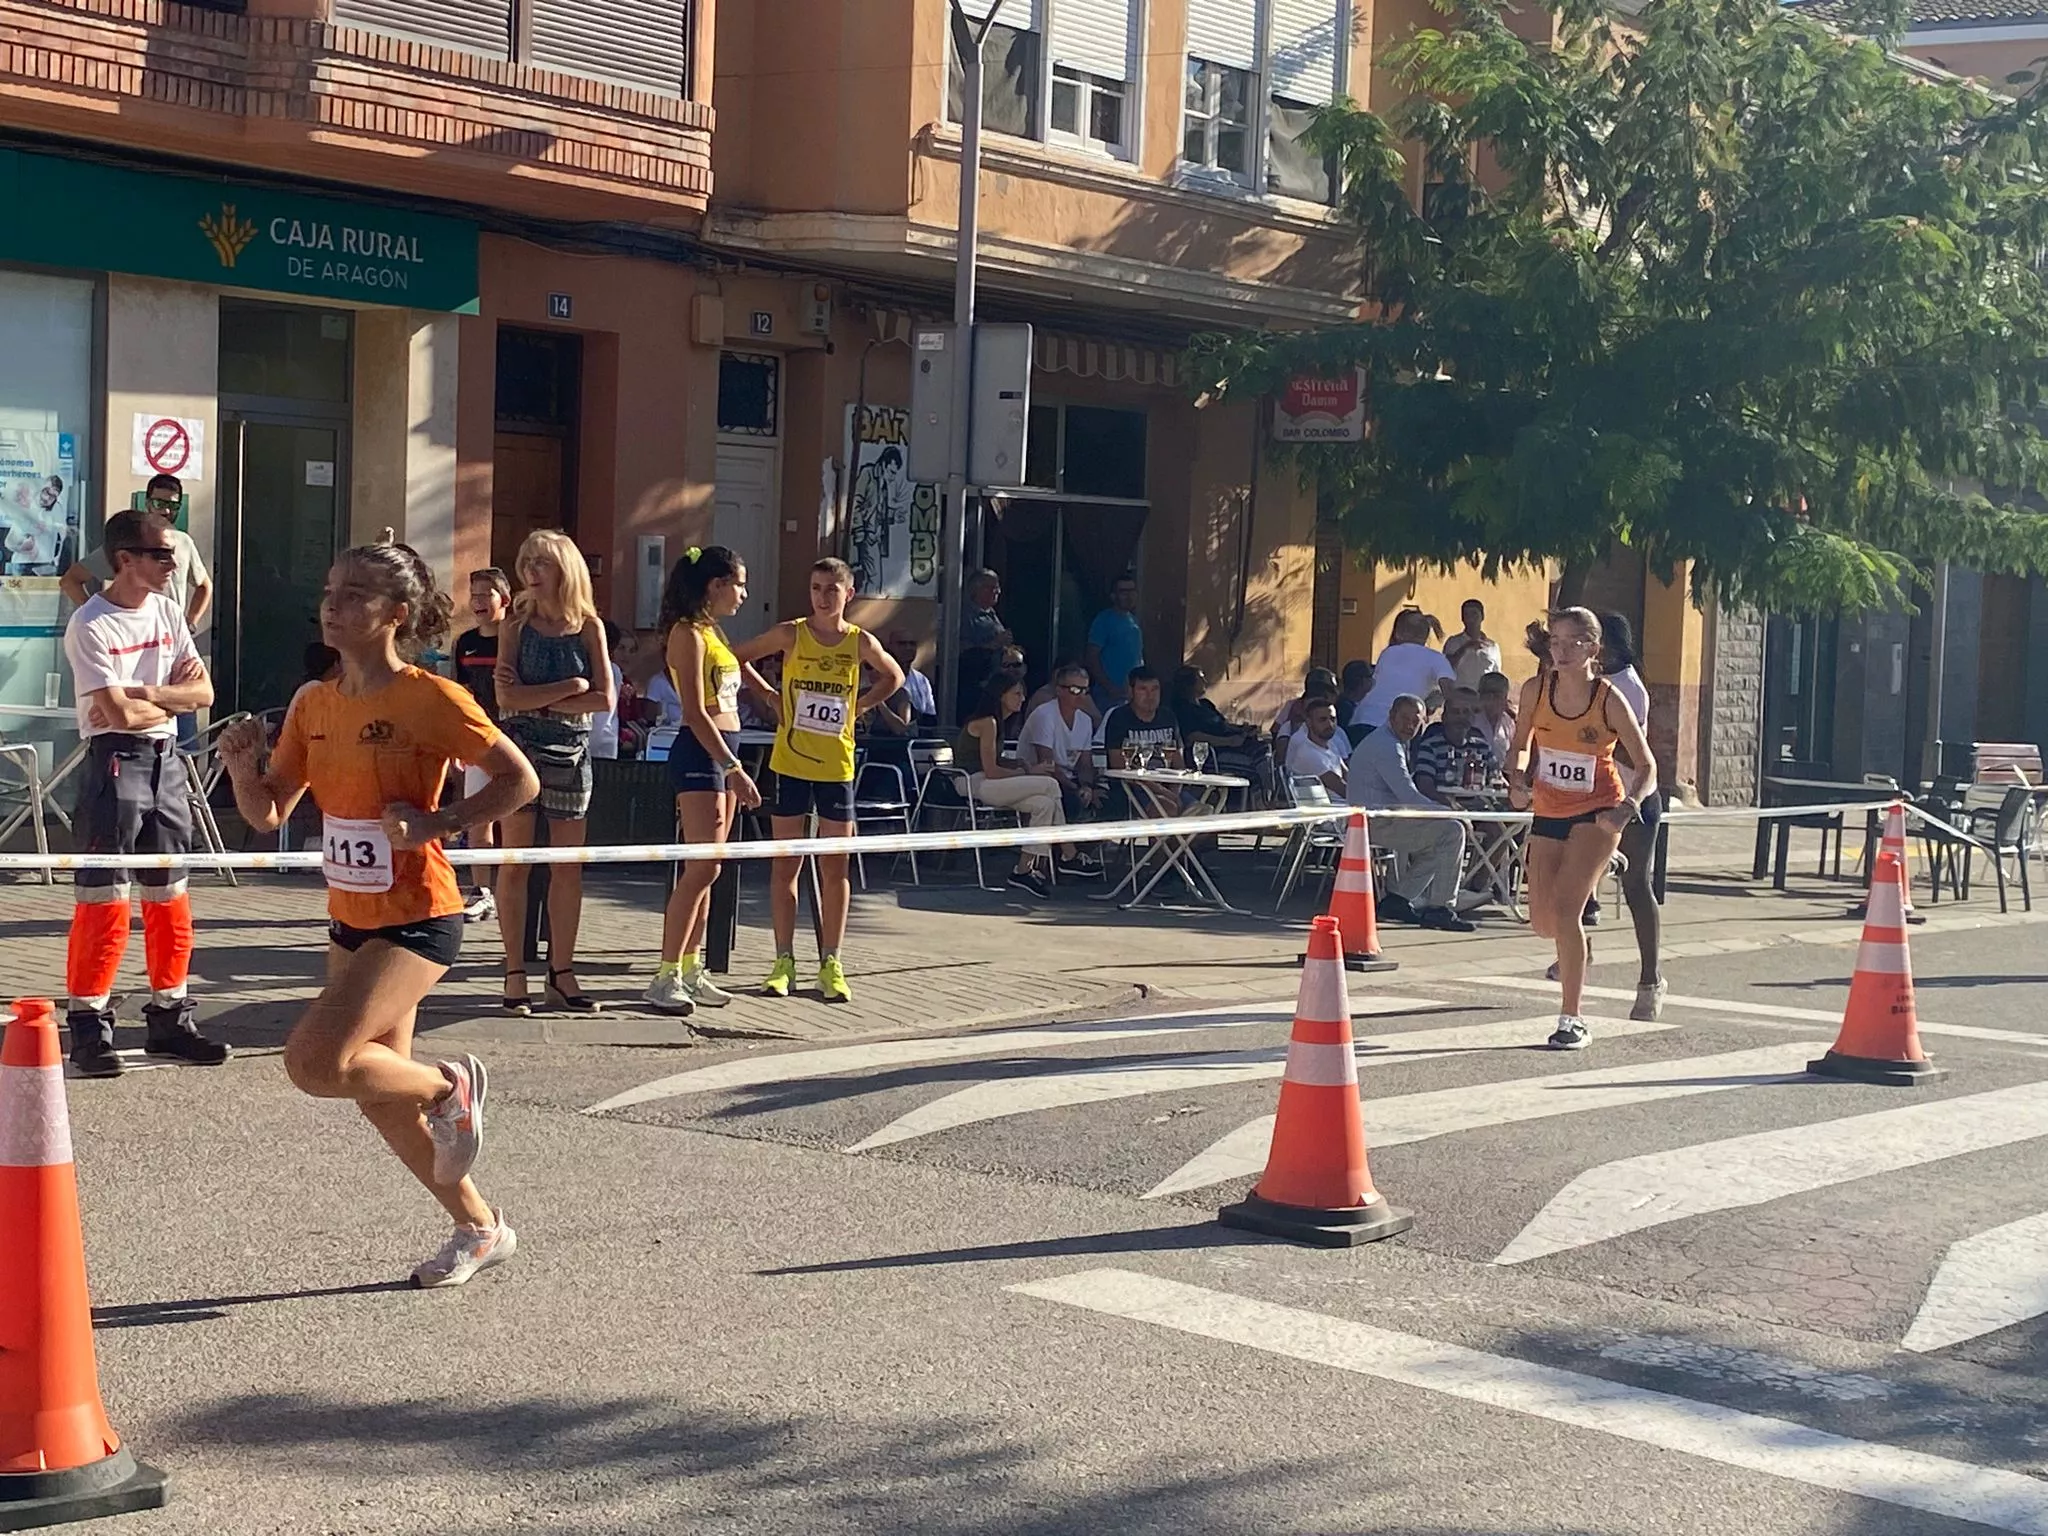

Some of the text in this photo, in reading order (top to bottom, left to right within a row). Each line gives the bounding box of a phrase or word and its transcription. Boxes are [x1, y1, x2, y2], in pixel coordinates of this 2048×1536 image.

[269, 217, 424, 263] CAJA RURAL
[287, 256, 408, 289] DE ARAGÓN
[553, 296, 569, 317] 14
[755, 313, 770, 333] 12
[852, 406, 910, 446] BAR
[910, 482, 937, 585] OMBO
[806, 703, 841, 723] 103
[1548, 762, 1586, 782] 108
[329, 836, 377, 868] 113
